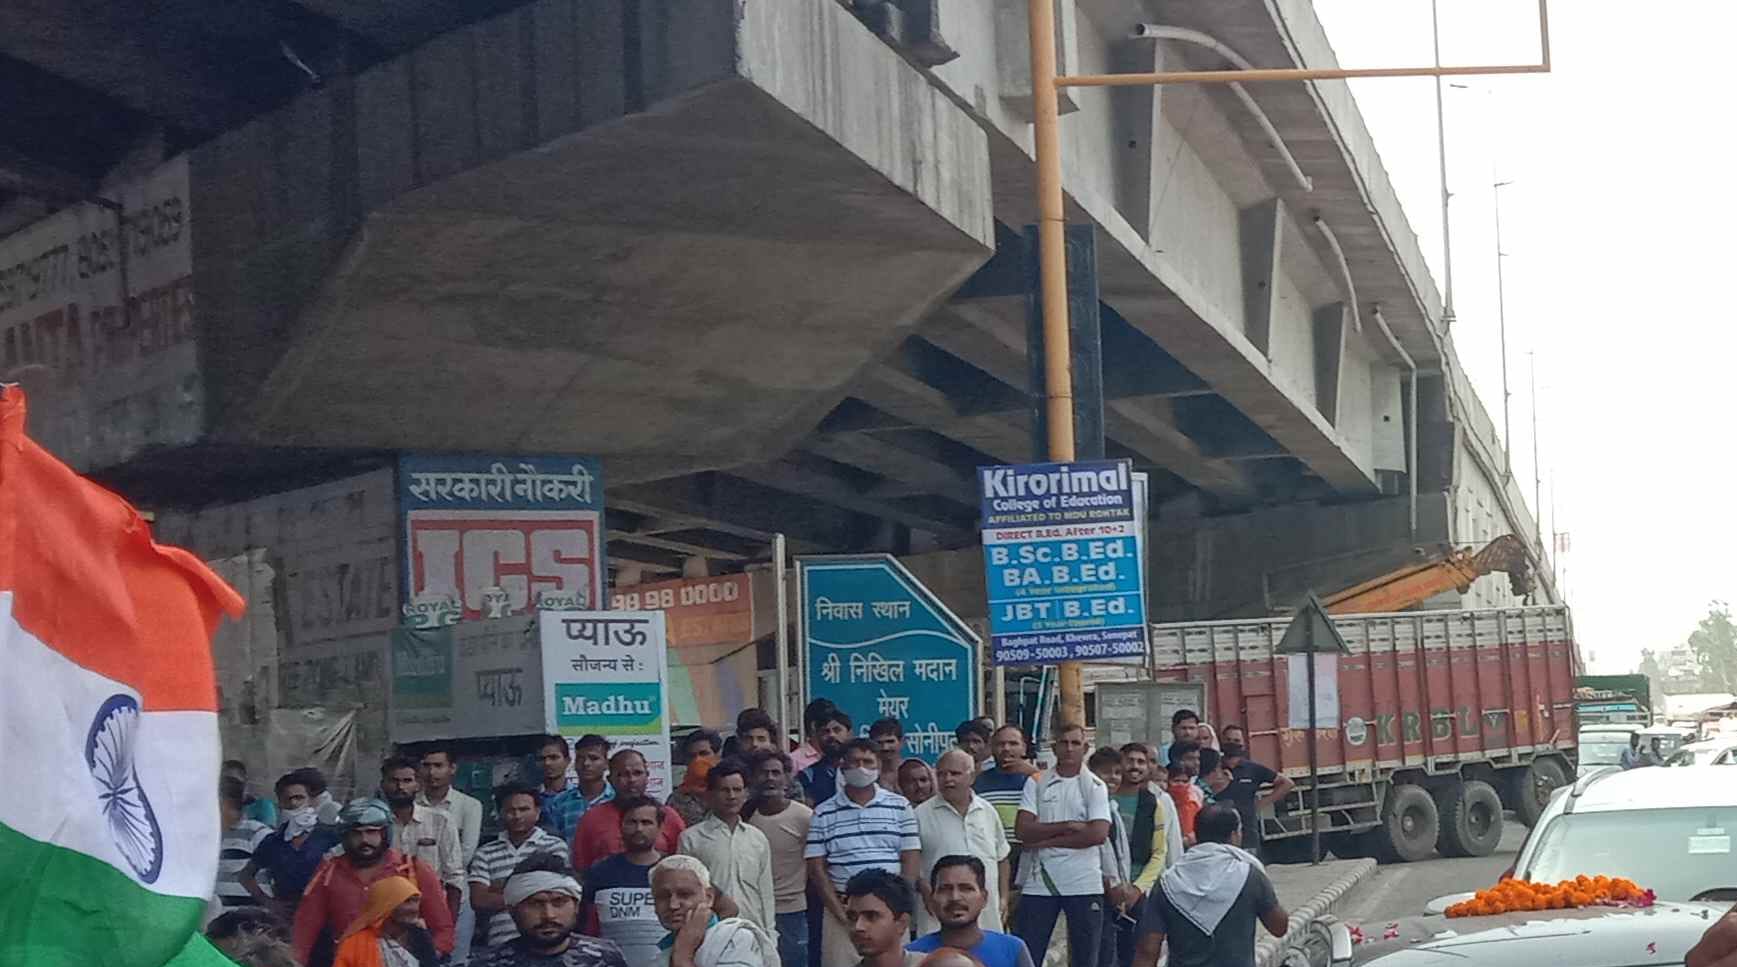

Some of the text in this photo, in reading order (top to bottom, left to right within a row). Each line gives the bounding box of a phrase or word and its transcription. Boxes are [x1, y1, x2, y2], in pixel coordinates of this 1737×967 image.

[983, 463, 1128, 498] Kirorimal
[993, 492, 1123, 512] College of Education
[988, 508, 1131, 524] AFFILIATED TO MDU ROHTAK
[996, 530, 1033, 541] DIRECT
[1065, 526, 1096, 538] After
[1099, 524, 1125, 535] 10+2
[416, 529, 590, 612] ICS
[644, 590, 672, 609] 98
[676, 583, 740, 607] 0000
[815, 597, 911, 620] निवास स्थान
[1001, 597, 1135, 622] JBT B.Ed.
[561, 618, 650, 646] प्याऊ
[821, 652, 957, 683] श्री निखिल मदान
[562, 695, 651, 715] Madhu
[876, 689, 910, 719] मेयर
[609, 892, 656, 906] SUPE
[609, 907, 640, 918] DNM
